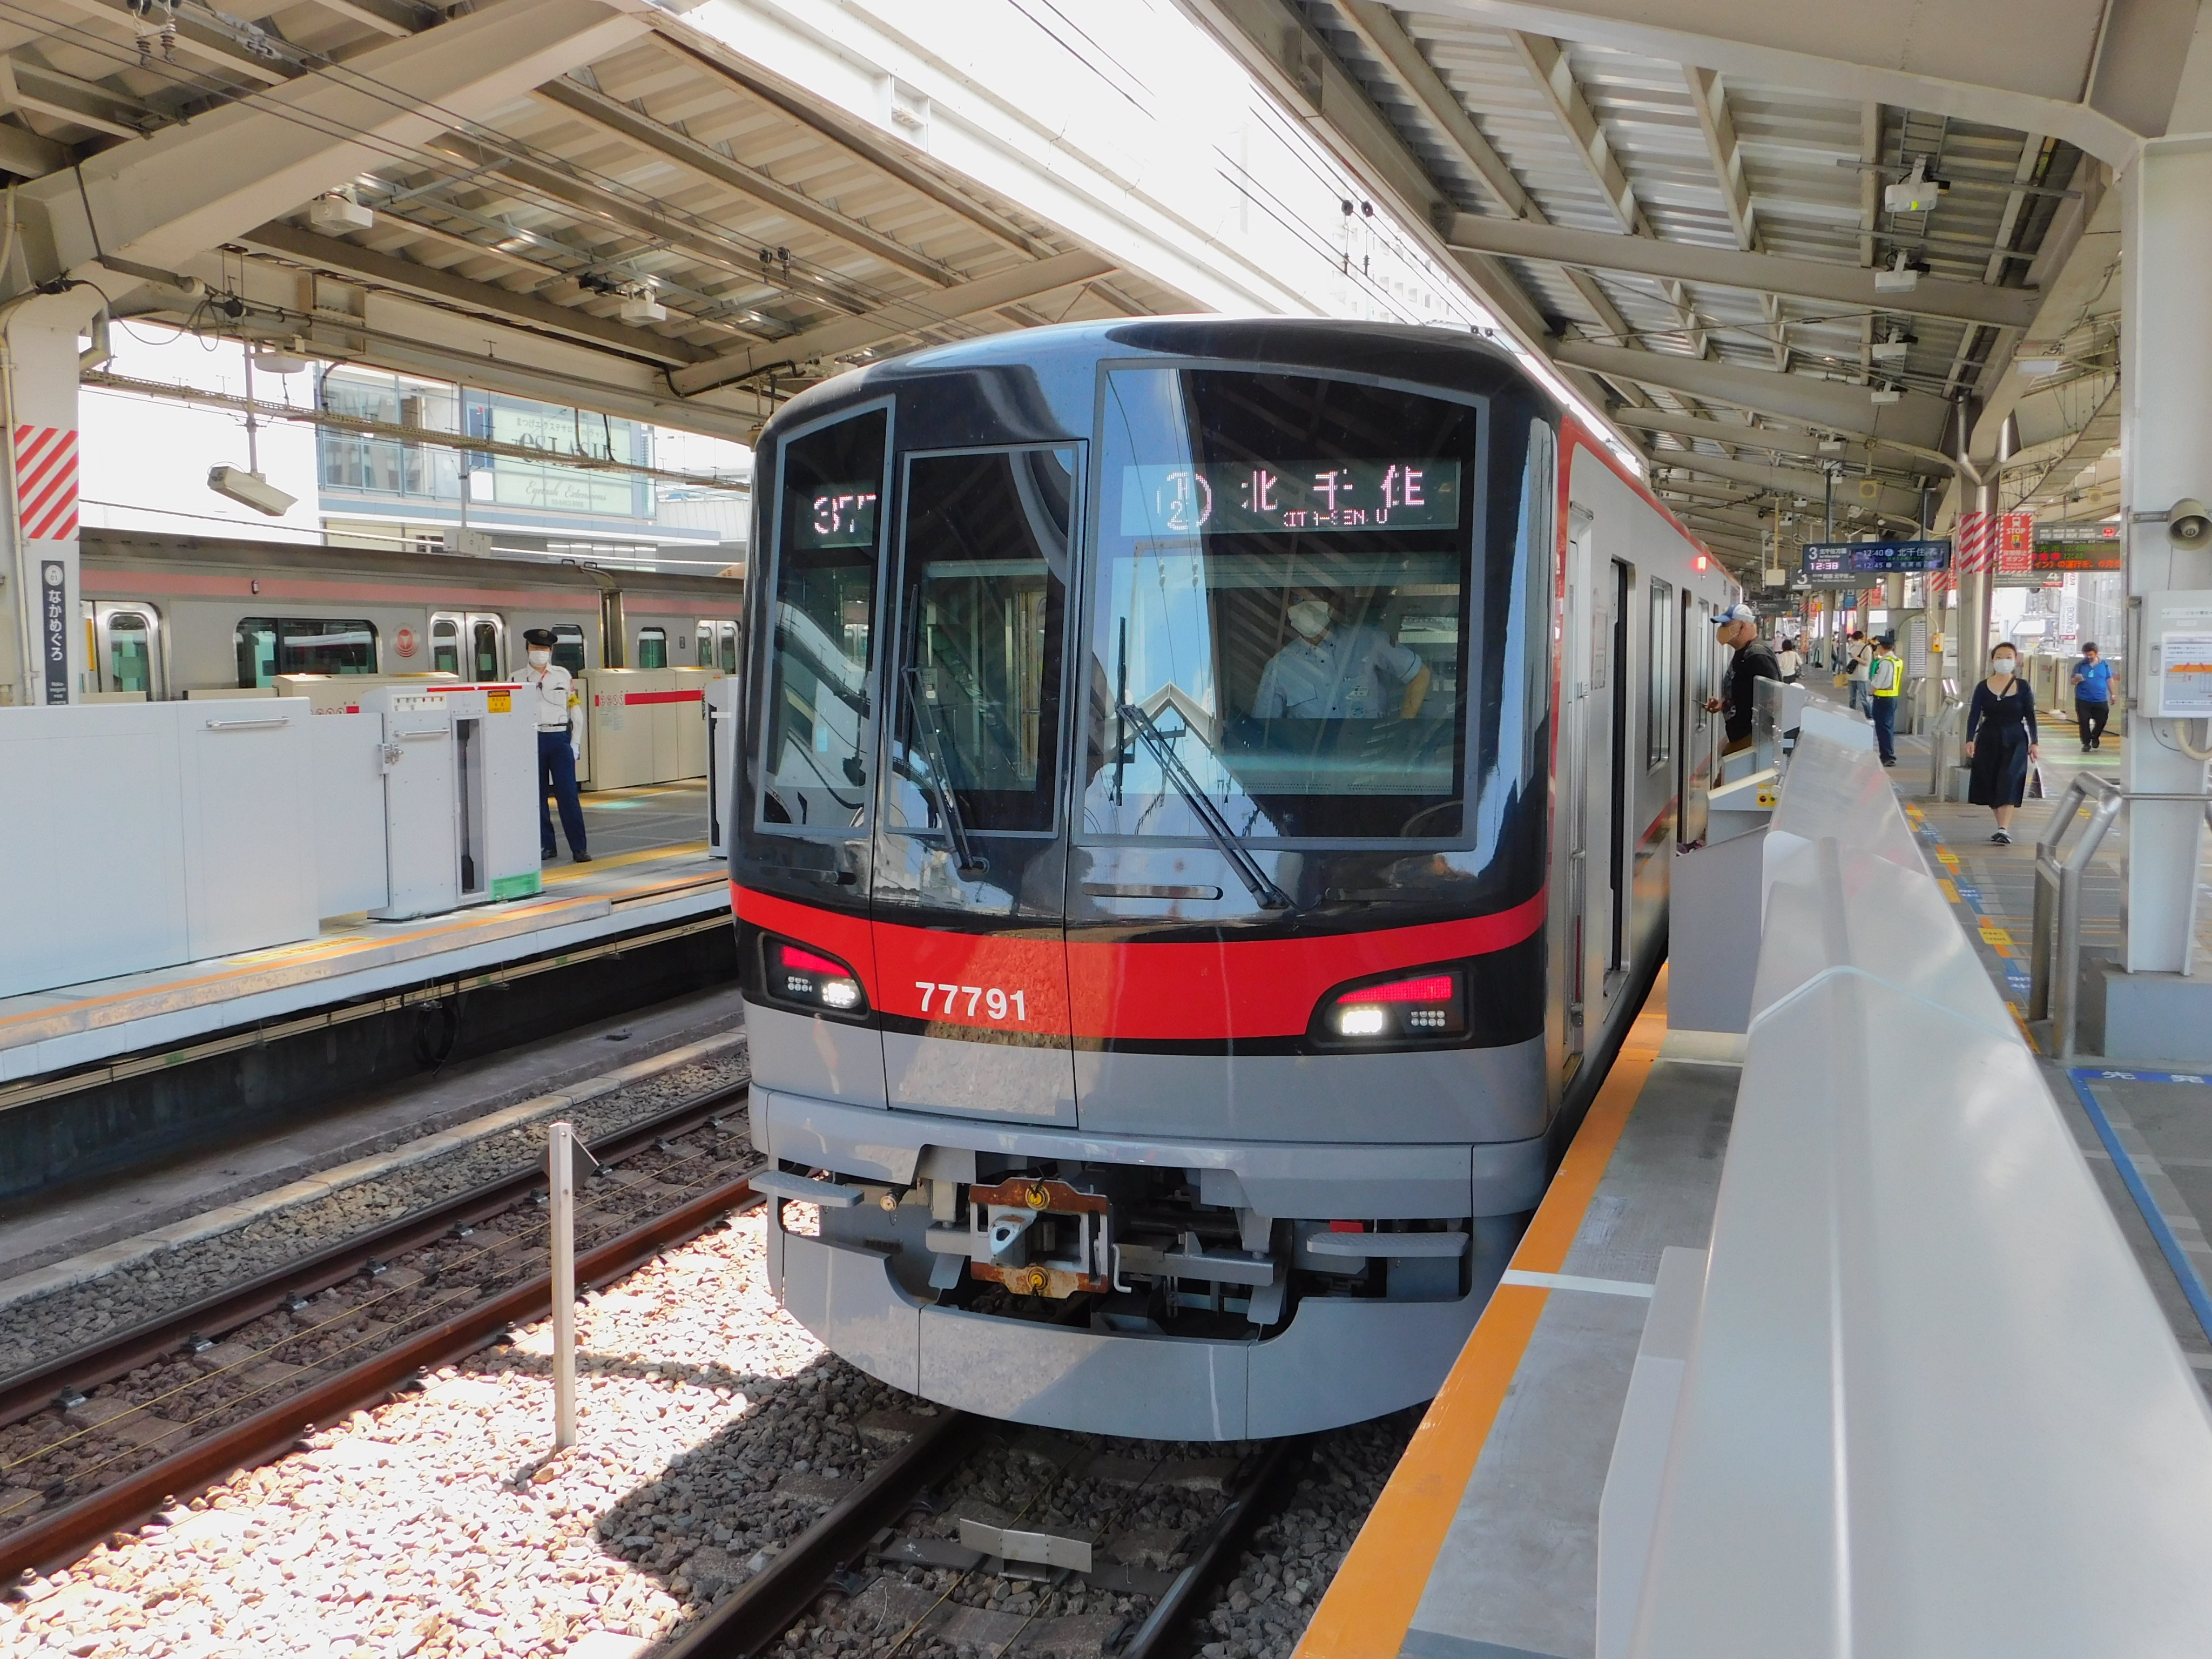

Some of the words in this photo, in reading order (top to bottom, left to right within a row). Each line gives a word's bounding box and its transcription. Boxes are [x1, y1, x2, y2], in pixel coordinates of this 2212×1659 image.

[1808, 547, 1818, 560] 3
[1897, 548, 1926, 556] 北千住
[1810, 562, 1838, 570] 12:38
[2046, 572, 2059, 581] 4
[49, 589, 63, 661] なかめぐろ
[915, 981, 1025, 1021] 77791
